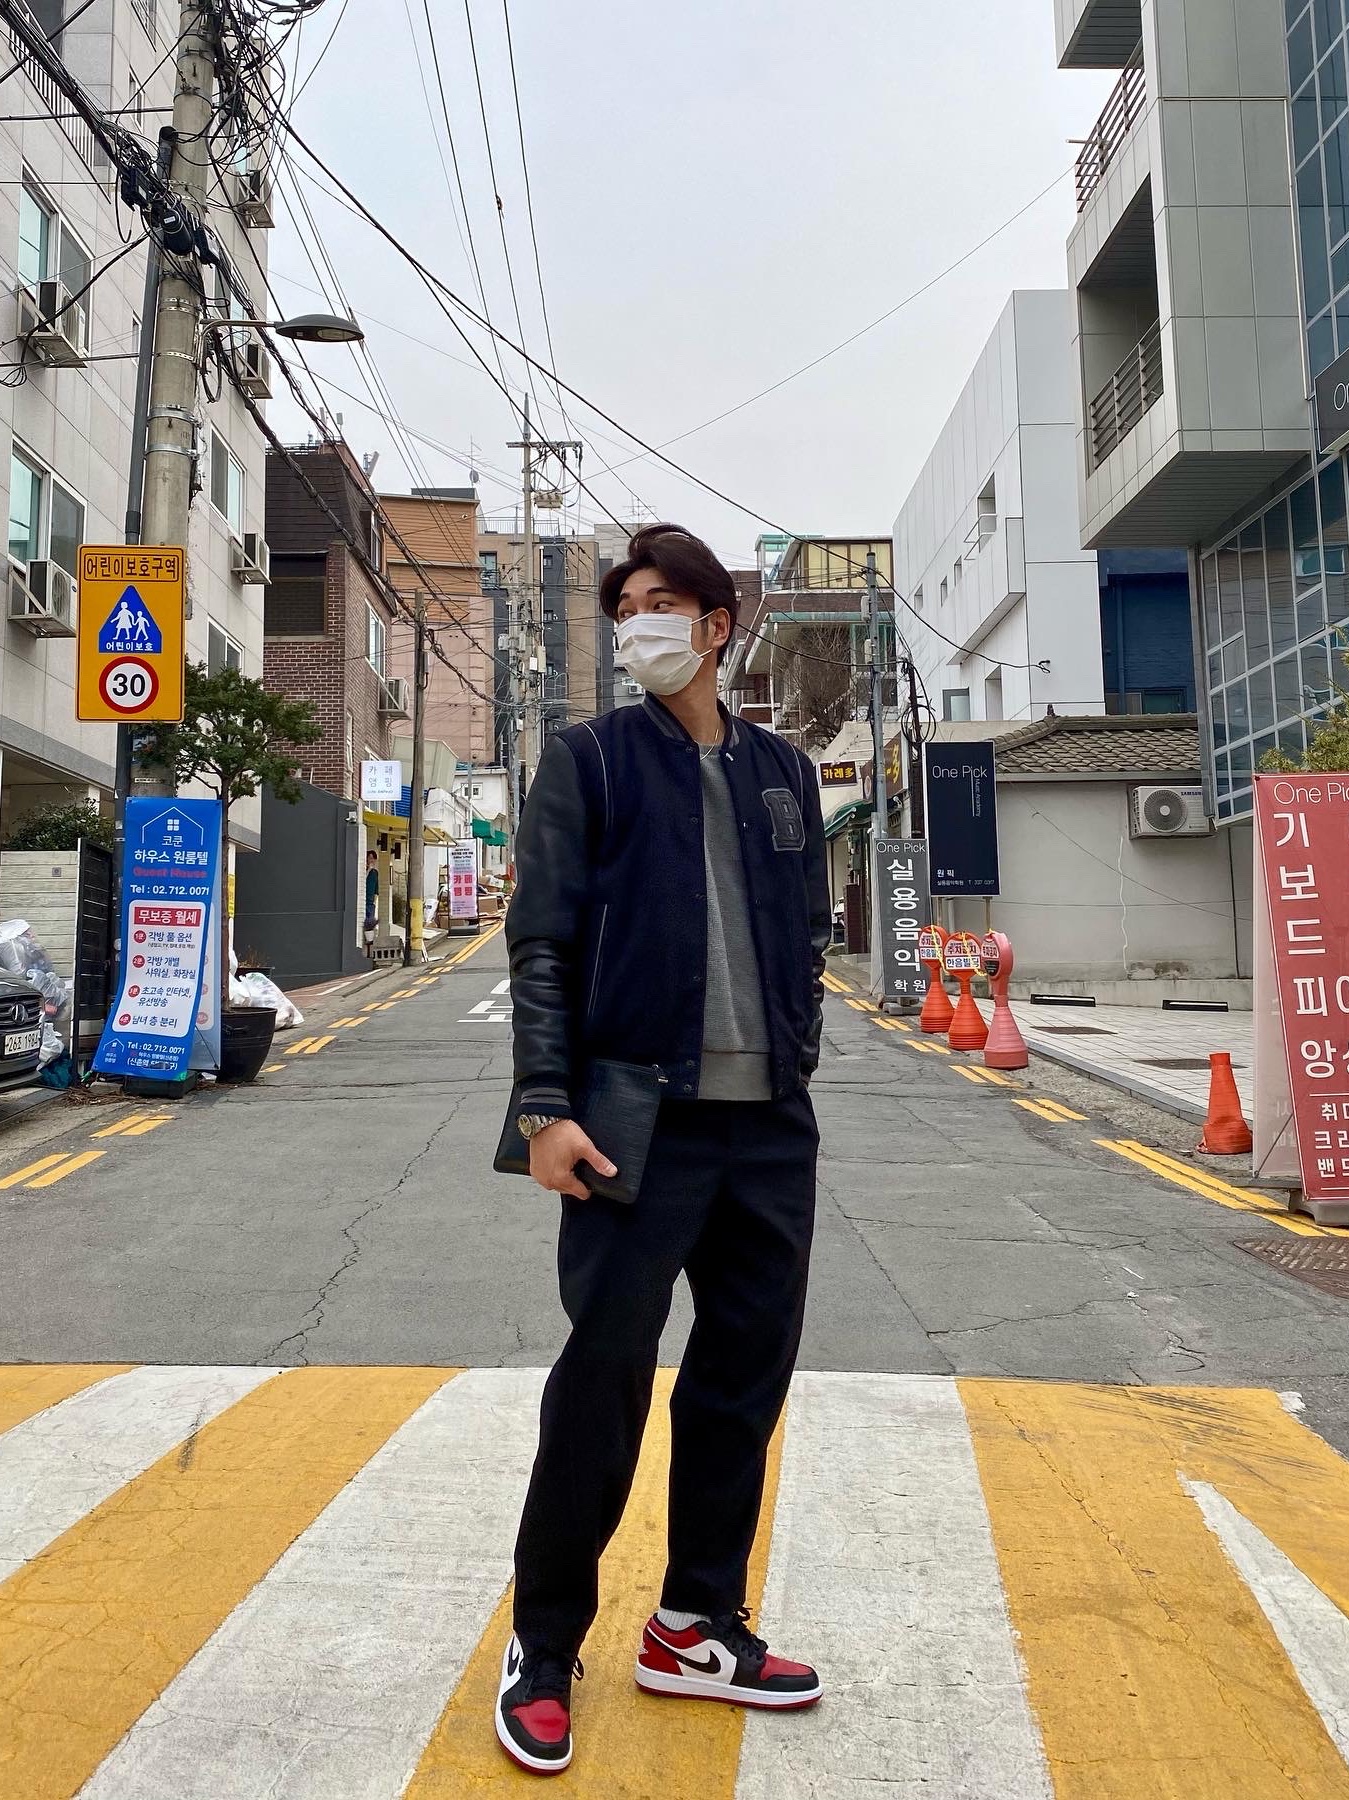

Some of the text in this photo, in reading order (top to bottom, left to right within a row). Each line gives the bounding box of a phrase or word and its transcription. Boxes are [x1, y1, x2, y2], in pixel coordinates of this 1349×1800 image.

[1334, 382, 1349, 411] O
[86, 557, 176, 579] 어린이보호구역
[106, 642, 153, 651] 어린이보호
[112, 673, 146, 697] 30
[822, 767, 855, 779] 카레多
[932, 765, 988, 778] One Pick
[1273, 781, 1349, 805] One Pi
[162, 835, 183, 847] 코쿤
[876, 842, 926, 853] One Pick
[134, 849, 209, 866] 하우스 원룸텔
[130, 885, 145, 894] Tel
[139, 910, 198, 925] 무보증 월세
[886, 858, 923, 972] 실용음악
[148, 931, 165, 942] 각방
[177, 932, 193, 943] 옵션
[147, 956, 163, 967] 각방
[164, 957, 180, 968] 개별
[173, 969, 196, 980] 화장실
[141, 987, 164, 997] 초고속
[894, 980, 926, 992] 학원
[137, 997, 168, 1007] 유선방송
[132, 1015, 148, 1025] 남녀
[149, 1016, 158, 1027] 층
[160, 1017, 177, 1028] 분리
[127, 1042, 138, 1050] Tel
